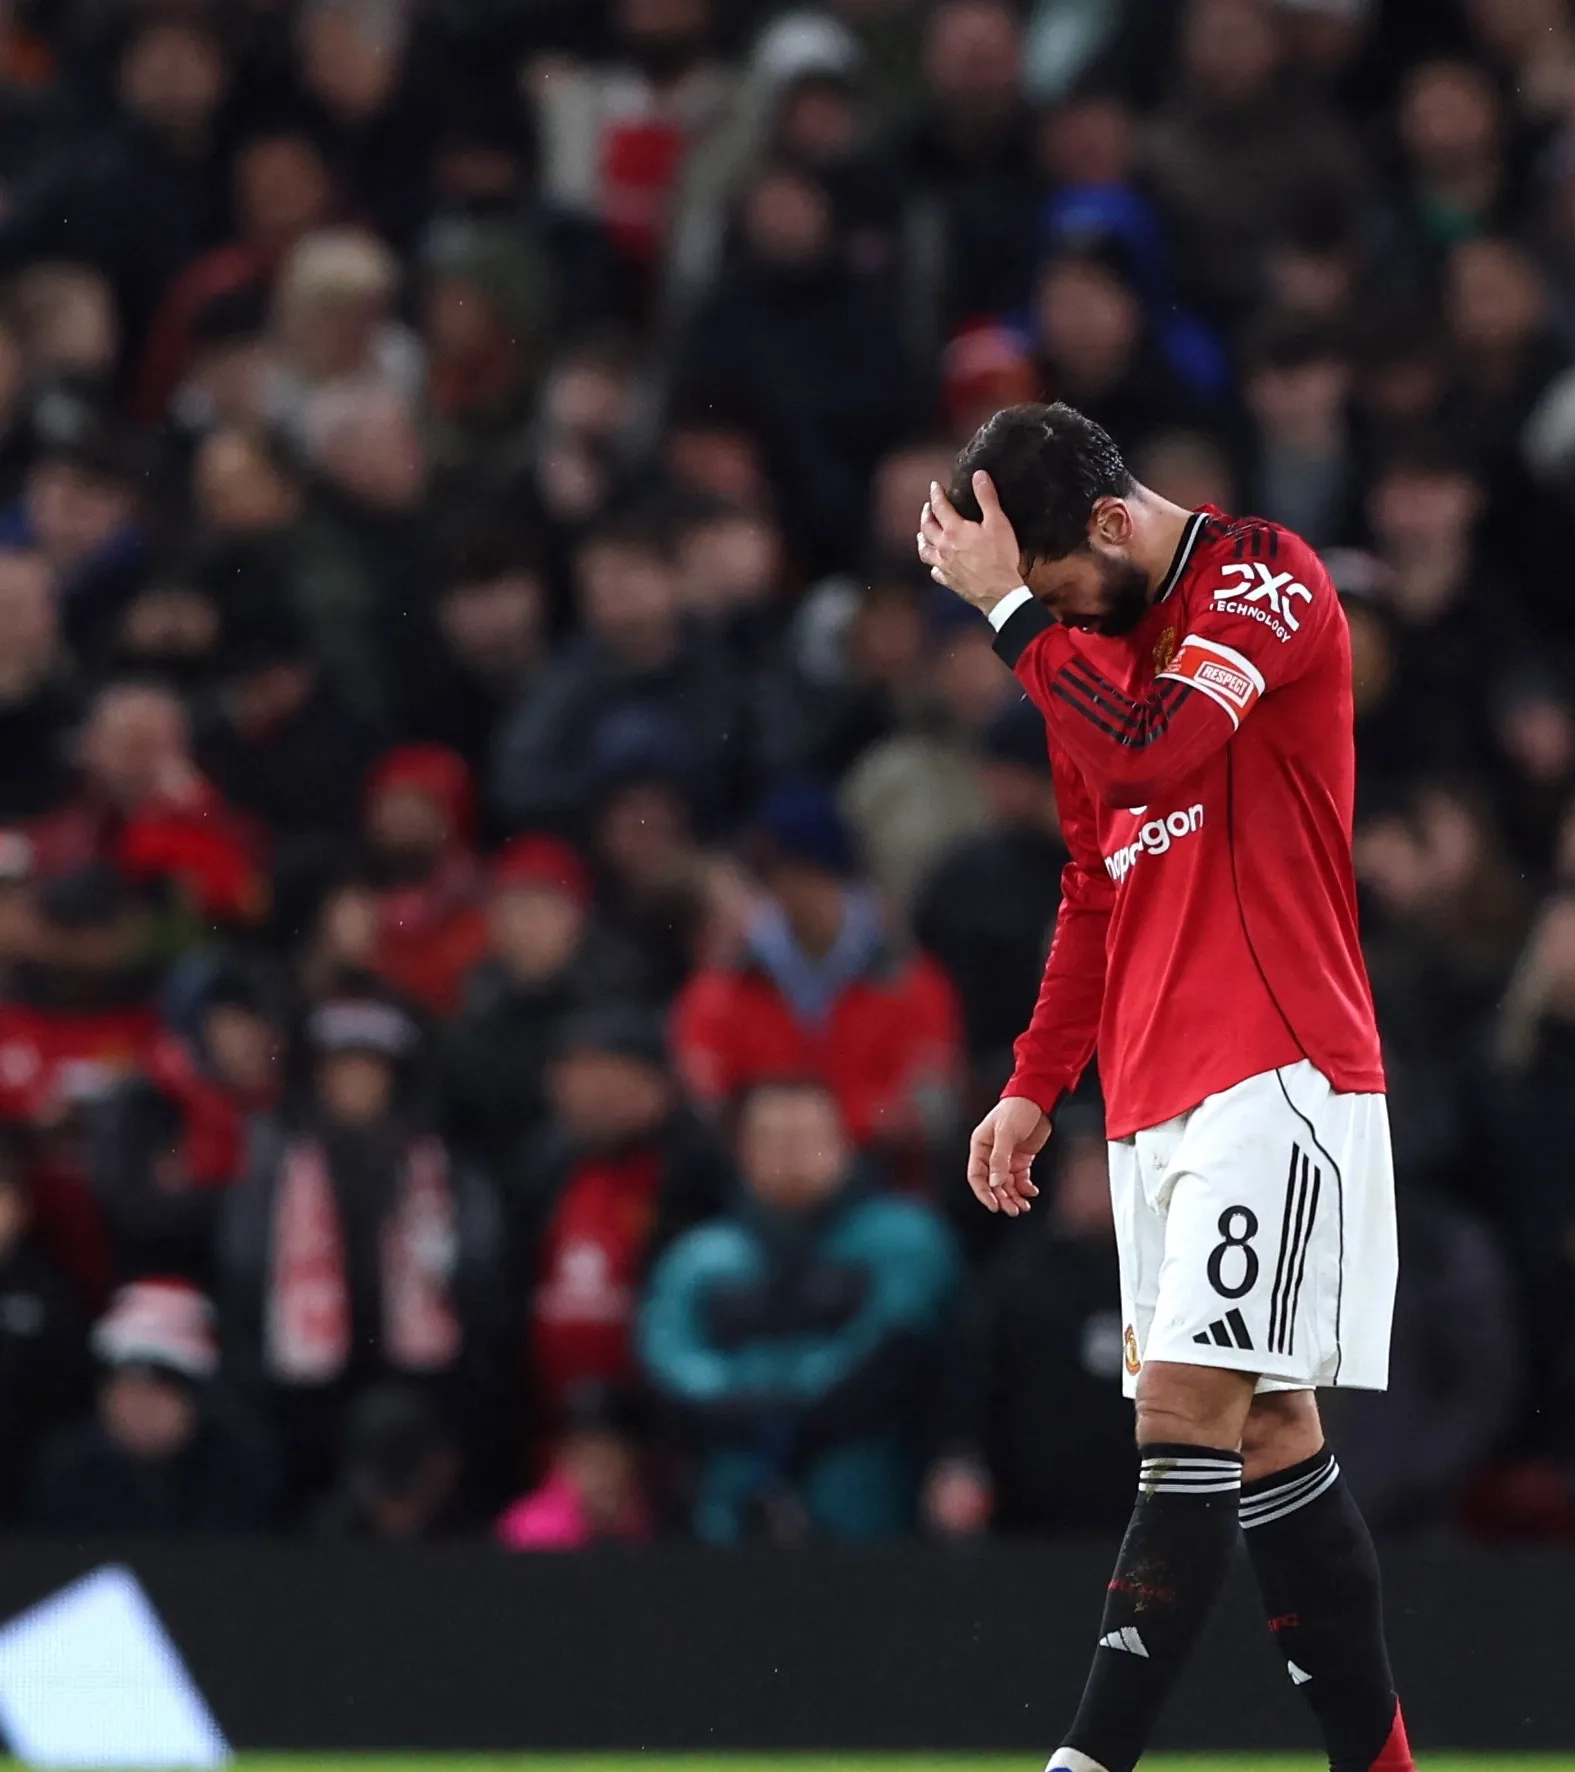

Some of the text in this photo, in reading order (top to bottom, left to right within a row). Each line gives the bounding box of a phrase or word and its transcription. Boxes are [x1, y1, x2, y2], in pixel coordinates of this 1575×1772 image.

[1214, 562, 1313, 632] DXC
[1201, 665, 1248, 696] RESPECT
[1206, 1204, 1259, 1299] 8
